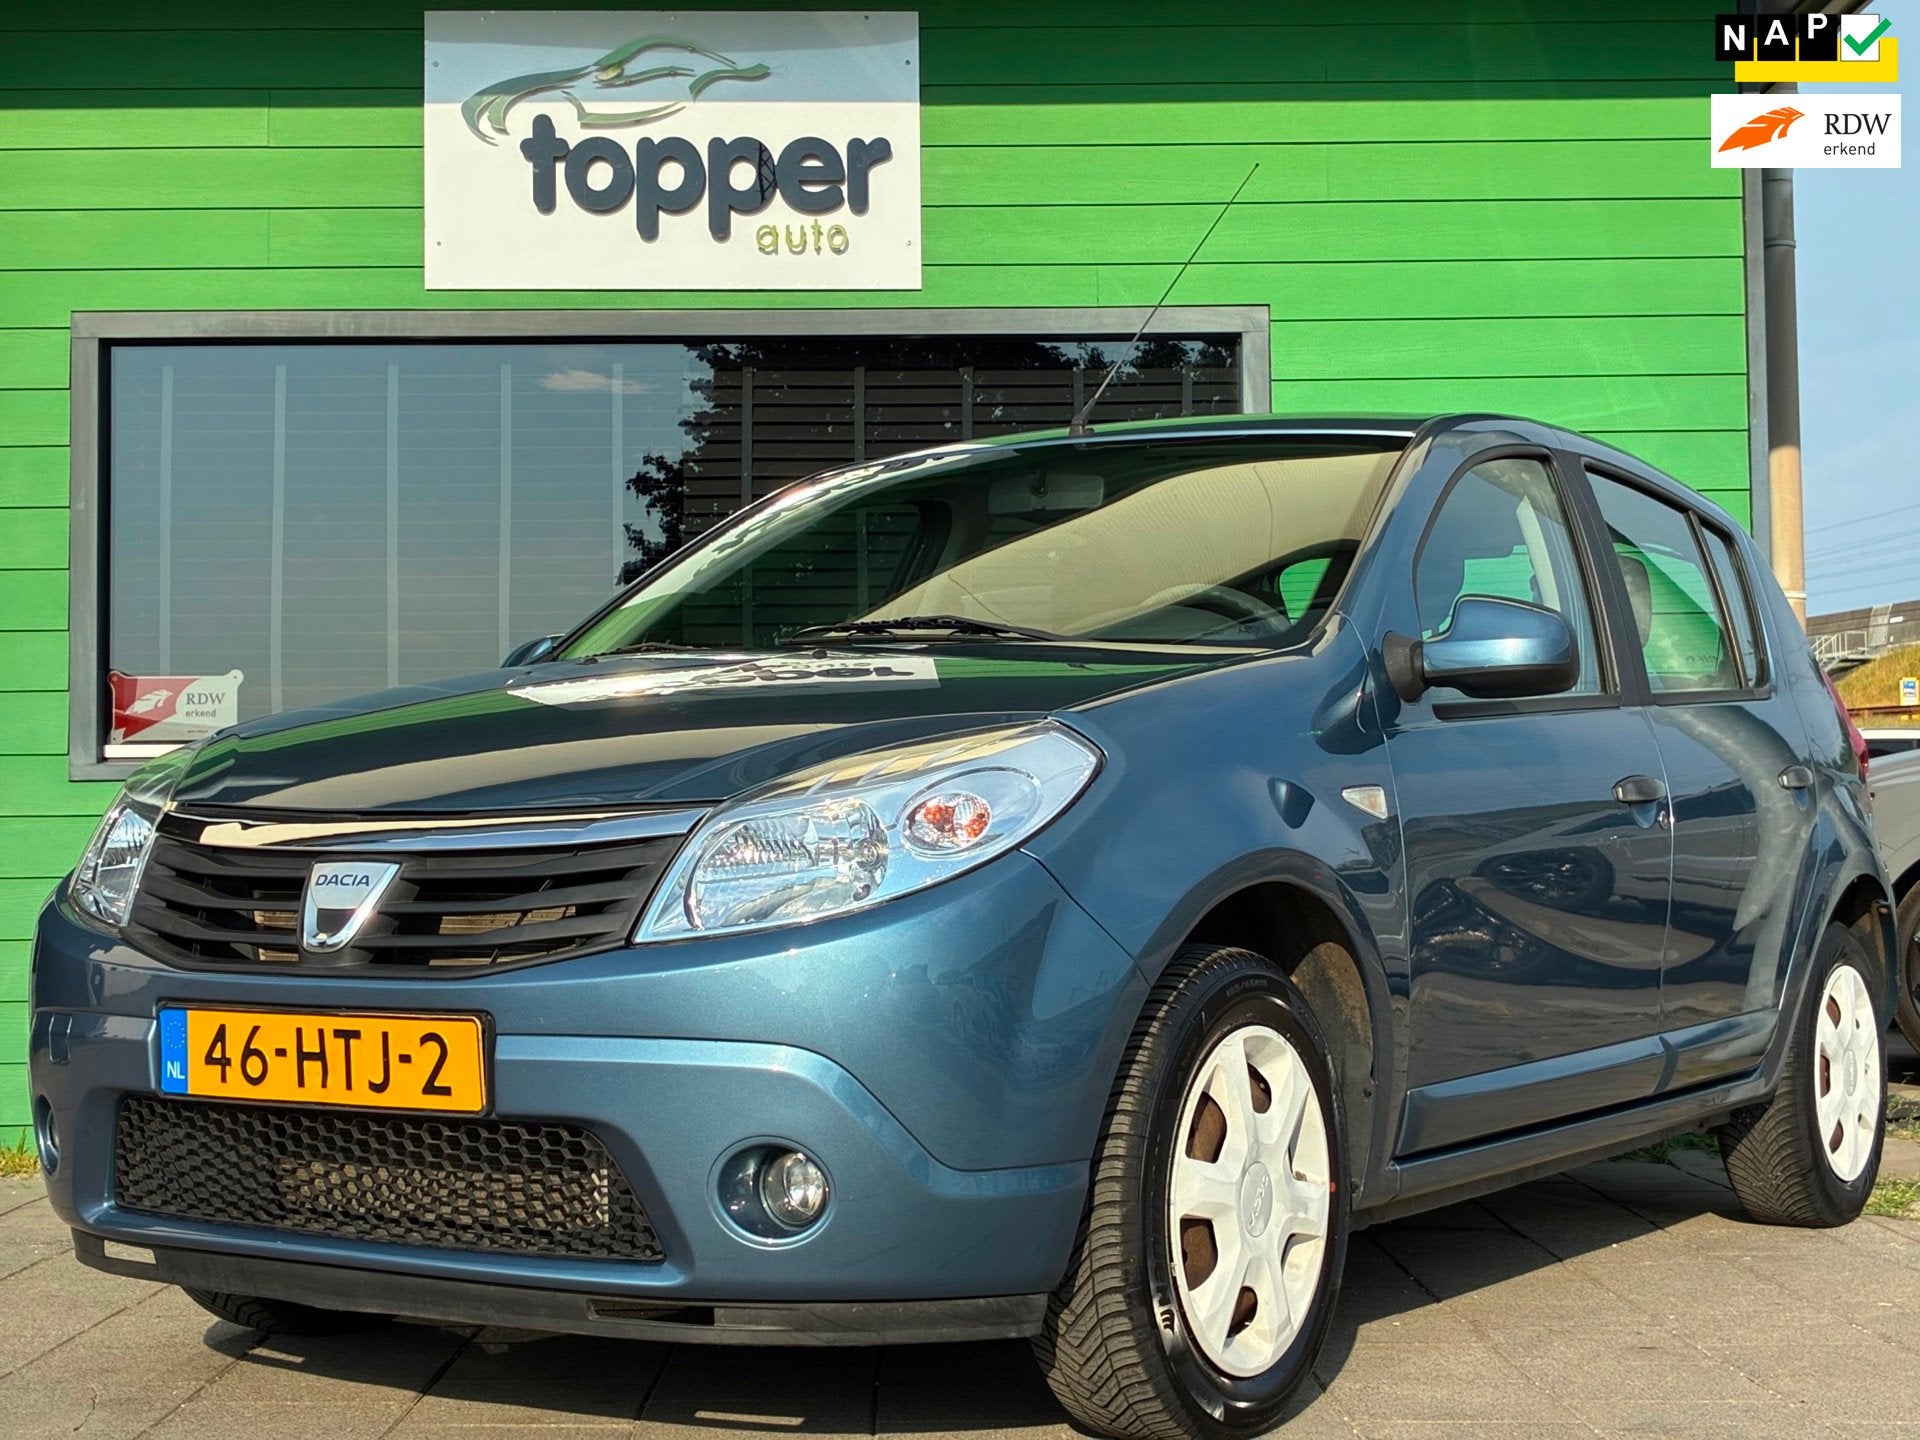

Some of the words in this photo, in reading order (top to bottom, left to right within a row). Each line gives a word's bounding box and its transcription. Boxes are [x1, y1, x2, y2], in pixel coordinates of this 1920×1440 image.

[520, 113, 892, 242] topper
[755, 218, 849, 254] auto
[186, 693, 225, 705] RDW
[185, 709, 216, 717] erkend
[315, 874, 370, 887] DACIA
[204, 1023, 452, 1096] 46-HTJ-2
[167, 1061, 185, 1080] NL
